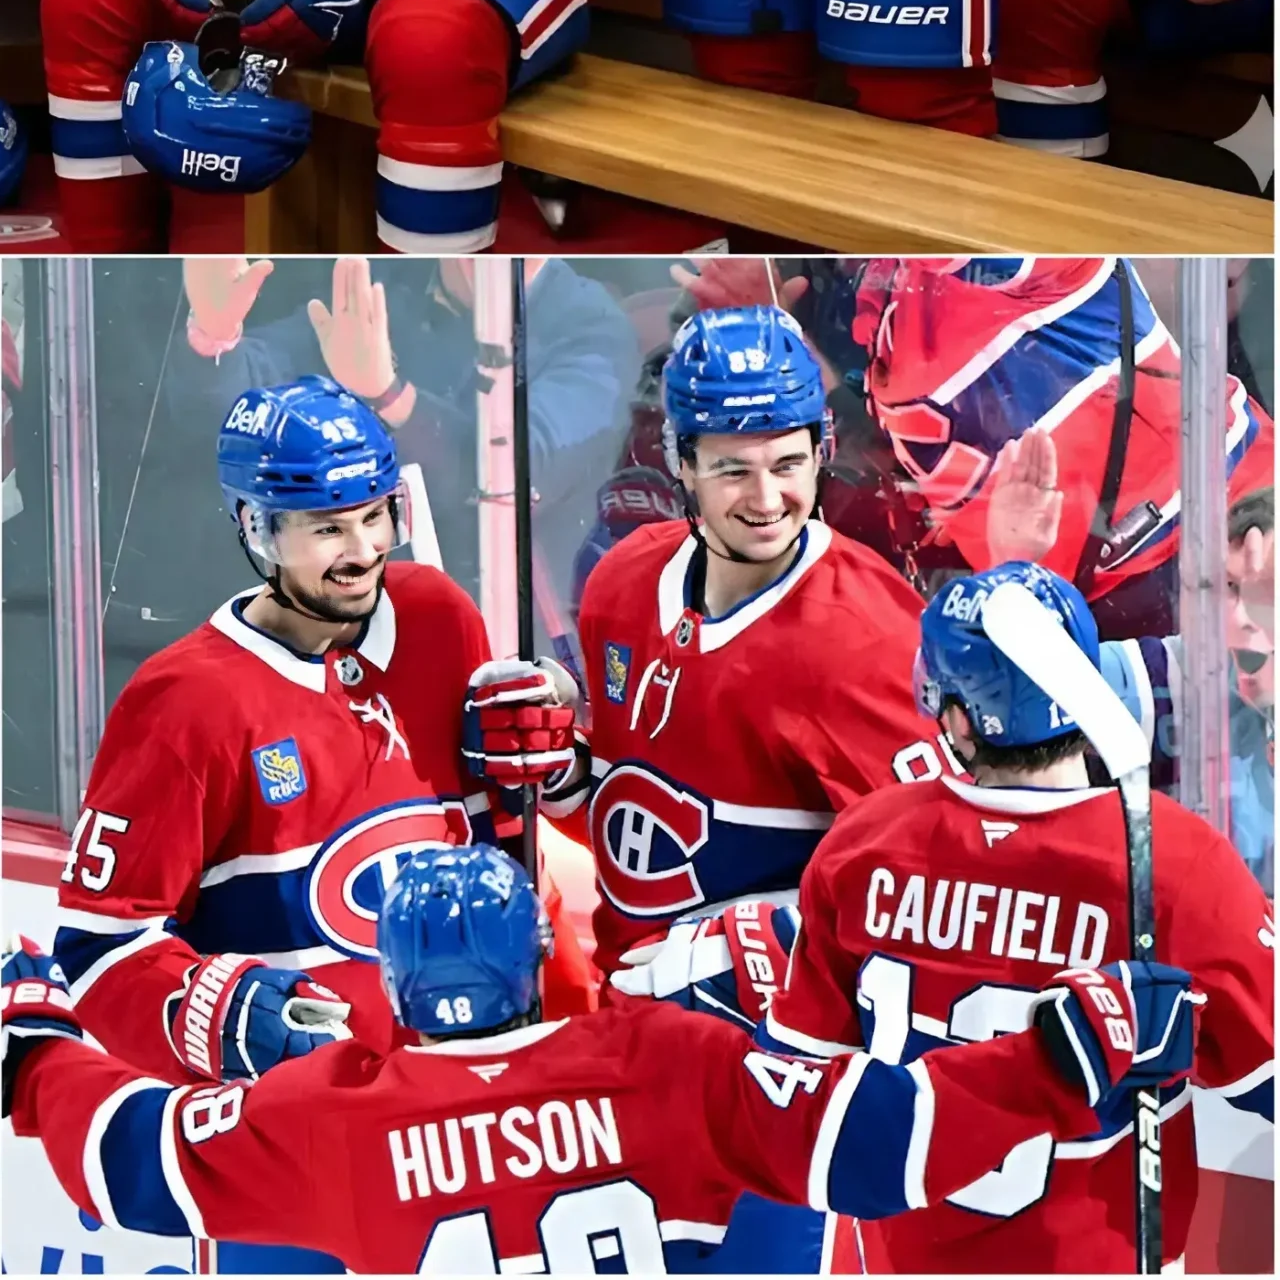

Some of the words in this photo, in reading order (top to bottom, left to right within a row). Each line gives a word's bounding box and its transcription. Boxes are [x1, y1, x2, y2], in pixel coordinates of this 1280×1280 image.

[60, 806, 131, 893] 45
[864, 866, 1110, 970] CAUFIELD
[434, 996, 473, 1024] 48
[182, 1085, 246, 1144] 8
[387, 1096, 623, 1202] HUTSON
